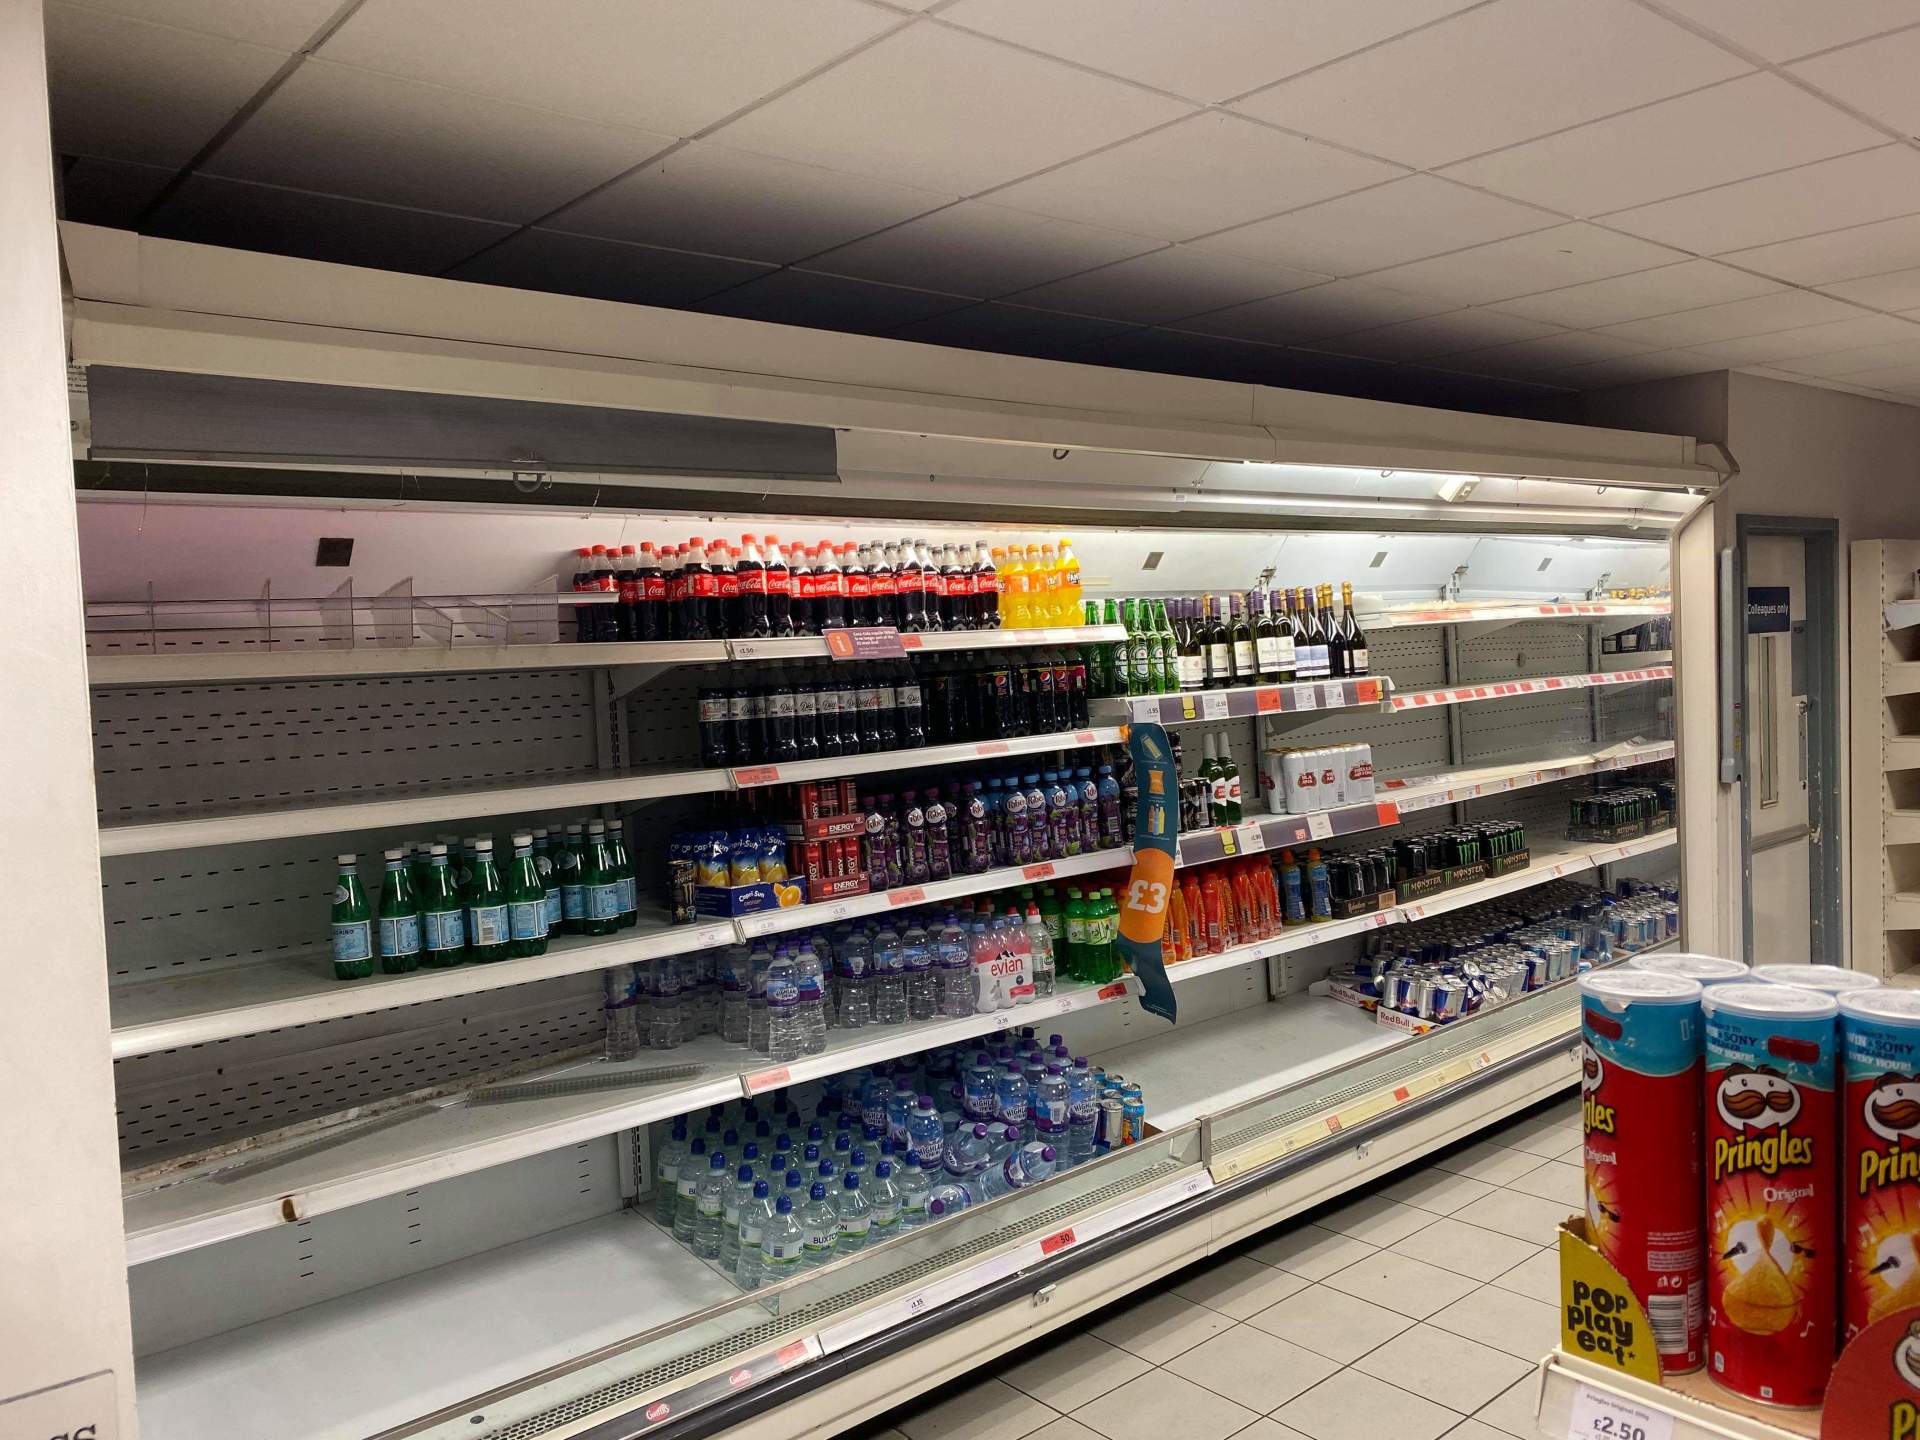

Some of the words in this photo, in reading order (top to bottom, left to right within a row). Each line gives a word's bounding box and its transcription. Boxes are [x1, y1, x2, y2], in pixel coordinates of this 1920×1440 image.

[1748, 604, 1777, 616] Colleagues
[1777, 603, 1788, 616] only
[829, 822, 855, 833] ENERGY
[1503, 853, 1528, 866] MONSTER
[1453, 865, 1484, 879] MONSTER
[834, 879, 859, 890] ENERGY
[1411, 875, 1442, 890] MONSTER
[738, 890, 765, 902] Capri-Sun
[1127, 879, 1167, 914] £3
[991, 957, 1024, 977] evian
[1380, 1011, 1395, 1022] Red
[1395, 1016, 1410, 1027] Bull
[1723, 1032, 1760, 1047] SONY
[1874, 1039, 1914, 1055] SONY
[1714, 1128, 1813, 1181] Pringles
[1860, 1147, 1920, 1195] Prin
[1763, 1184, 1814, 1203] Original
[1567, 1305, 1633, 1347] play
[1593, 1416, 1646, 1440] £2.50
